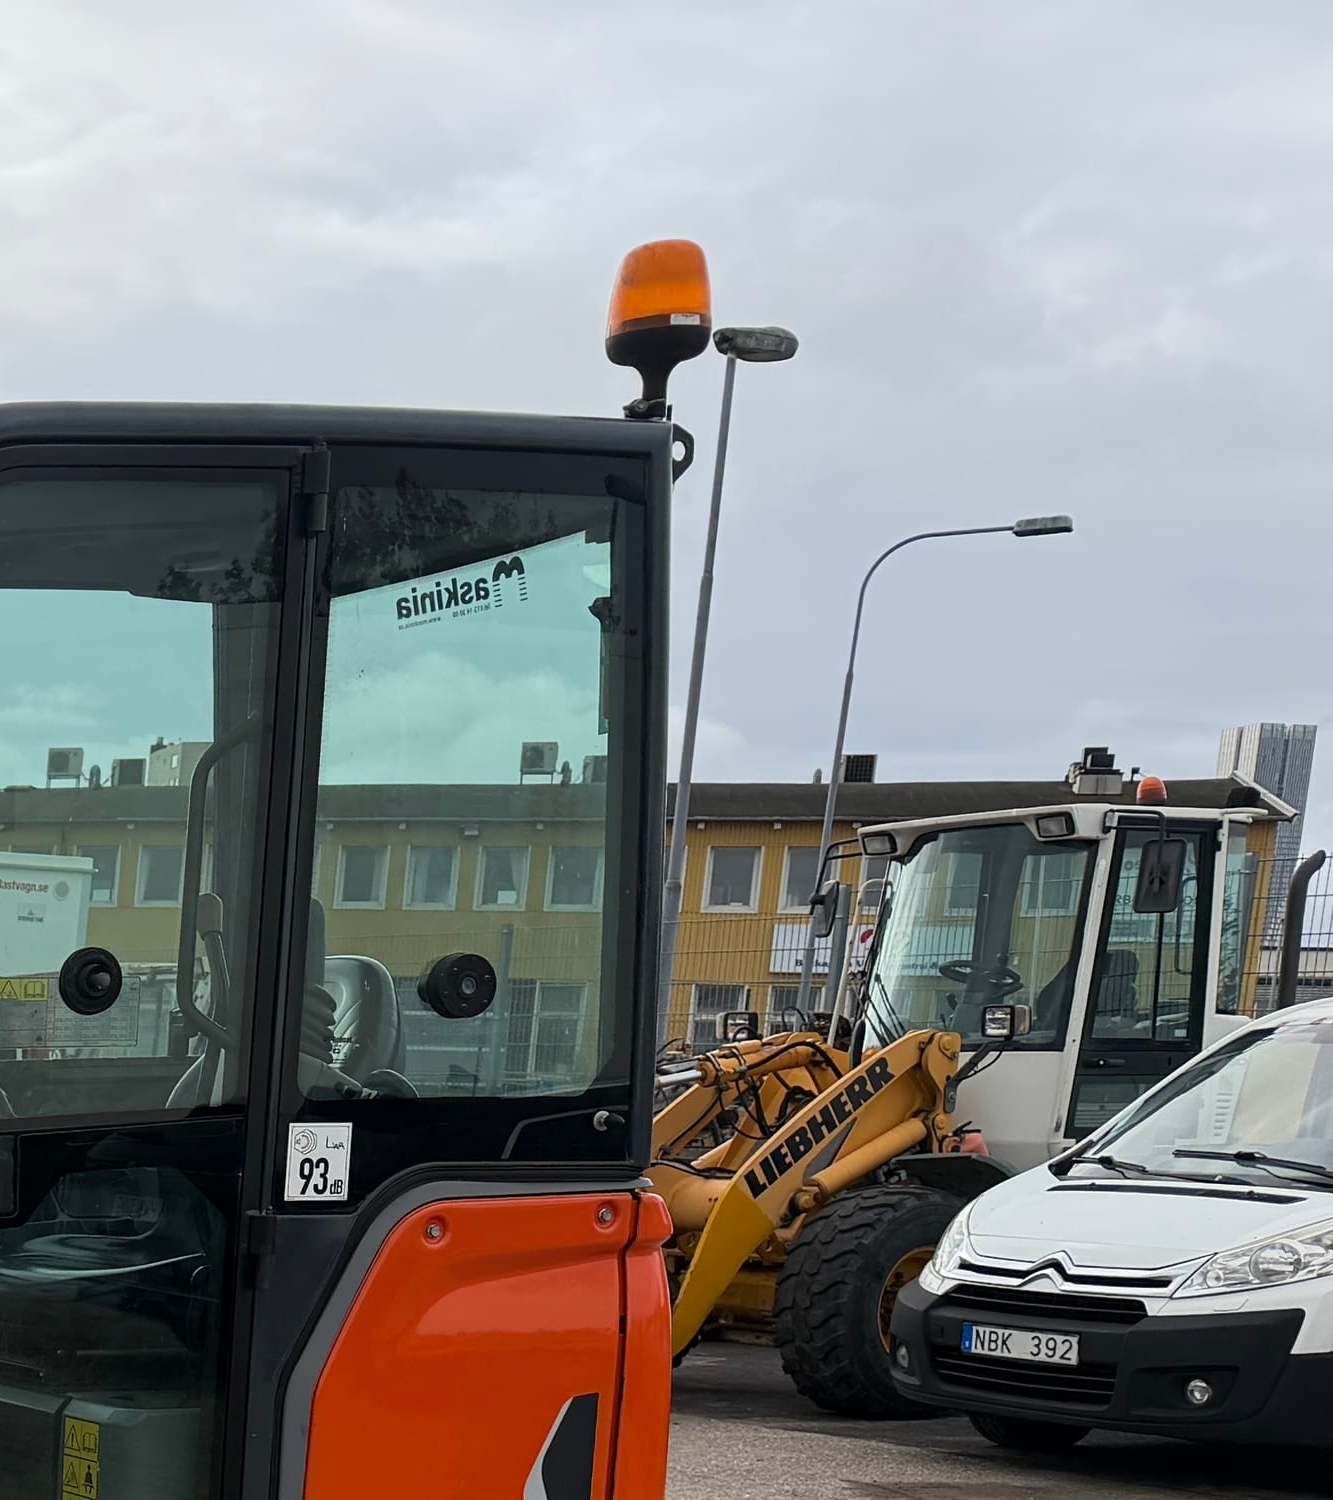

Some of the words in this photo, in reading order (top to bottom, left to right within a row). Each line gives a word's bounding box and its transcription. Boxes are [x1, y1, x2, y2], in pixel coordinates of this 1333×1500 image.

[744, 1057, 895, 1199] LIEBHERR
[299, 1157, 329, 1195] 93
[330, 1179, 343, 1194] dB
[974, 1329, 1013, 1354] NBK
[1030, 1336, 1073, 1361] 392
